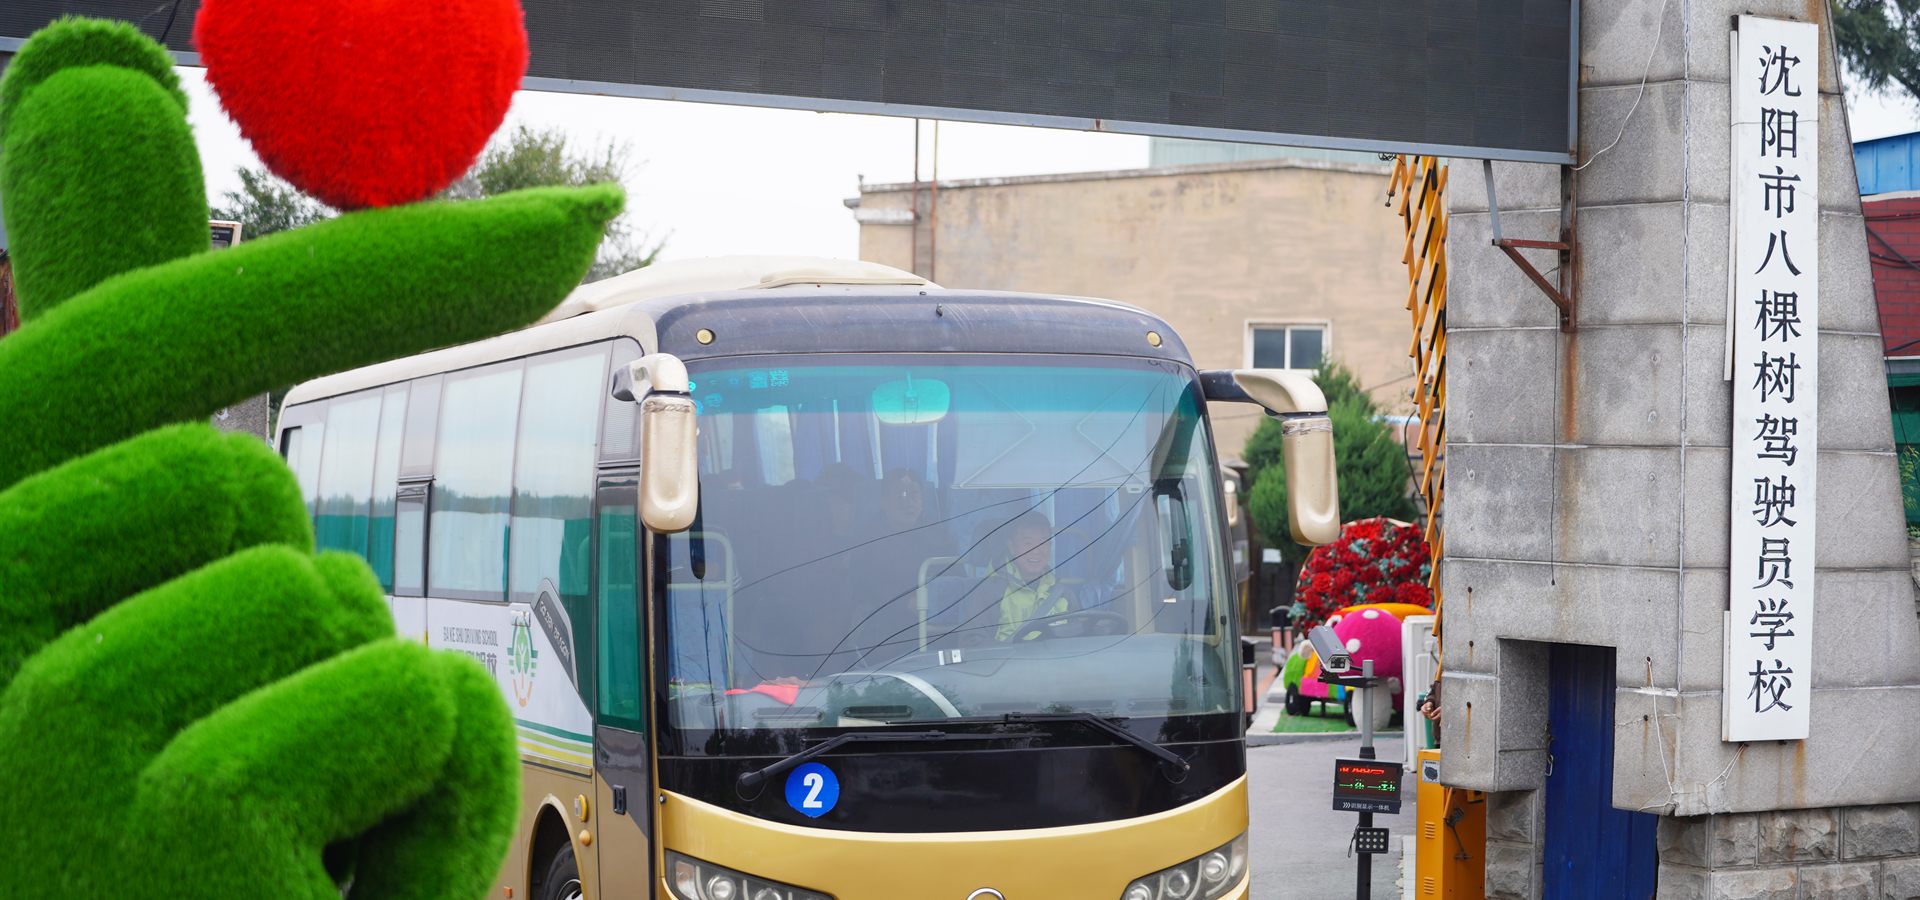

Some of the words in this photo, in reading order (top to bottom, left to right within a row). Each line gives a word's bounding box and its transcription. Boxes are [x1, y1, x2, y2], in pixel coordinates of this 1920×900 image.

[1747, 45, 1802, 714] 沈阳市八棵树驾驶员学校
[803, 772, 824, 809] 2
